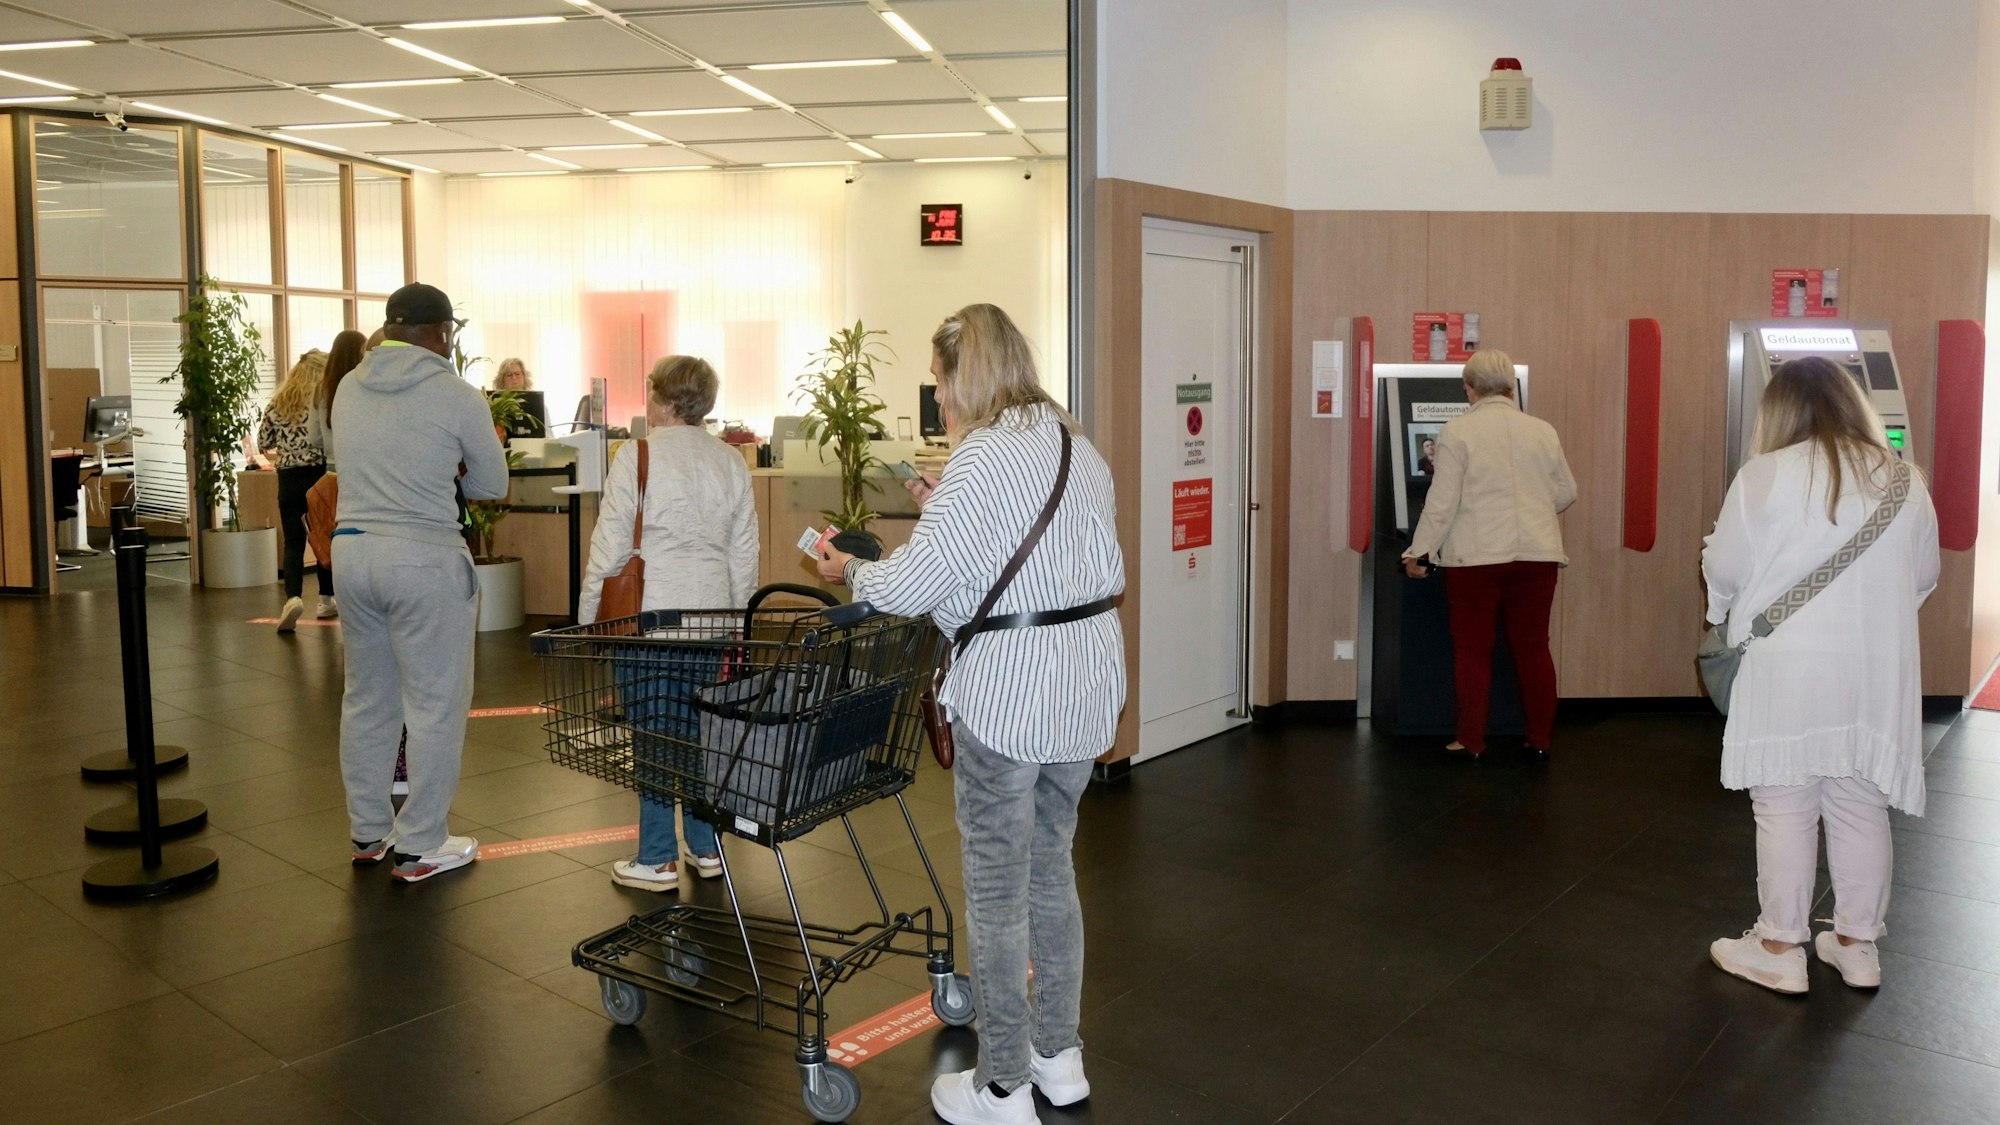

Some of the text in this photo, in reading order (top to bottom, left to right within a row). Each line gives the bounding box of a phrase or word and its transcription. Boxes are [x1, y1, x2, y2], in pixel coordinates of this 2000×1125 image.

[1767, 334, 1851, 345] Geldautomat
[1177, 388, 1211, 399] Notausgang
[1174, 485, 1210, 498] Läuft wieder.
[488, 845, 519, 853] Bitte
[522, 839, 562, 848] halten
[856, 1006, 931, 1043] Bitte halten
[884, 1026, 912, 1042] und
